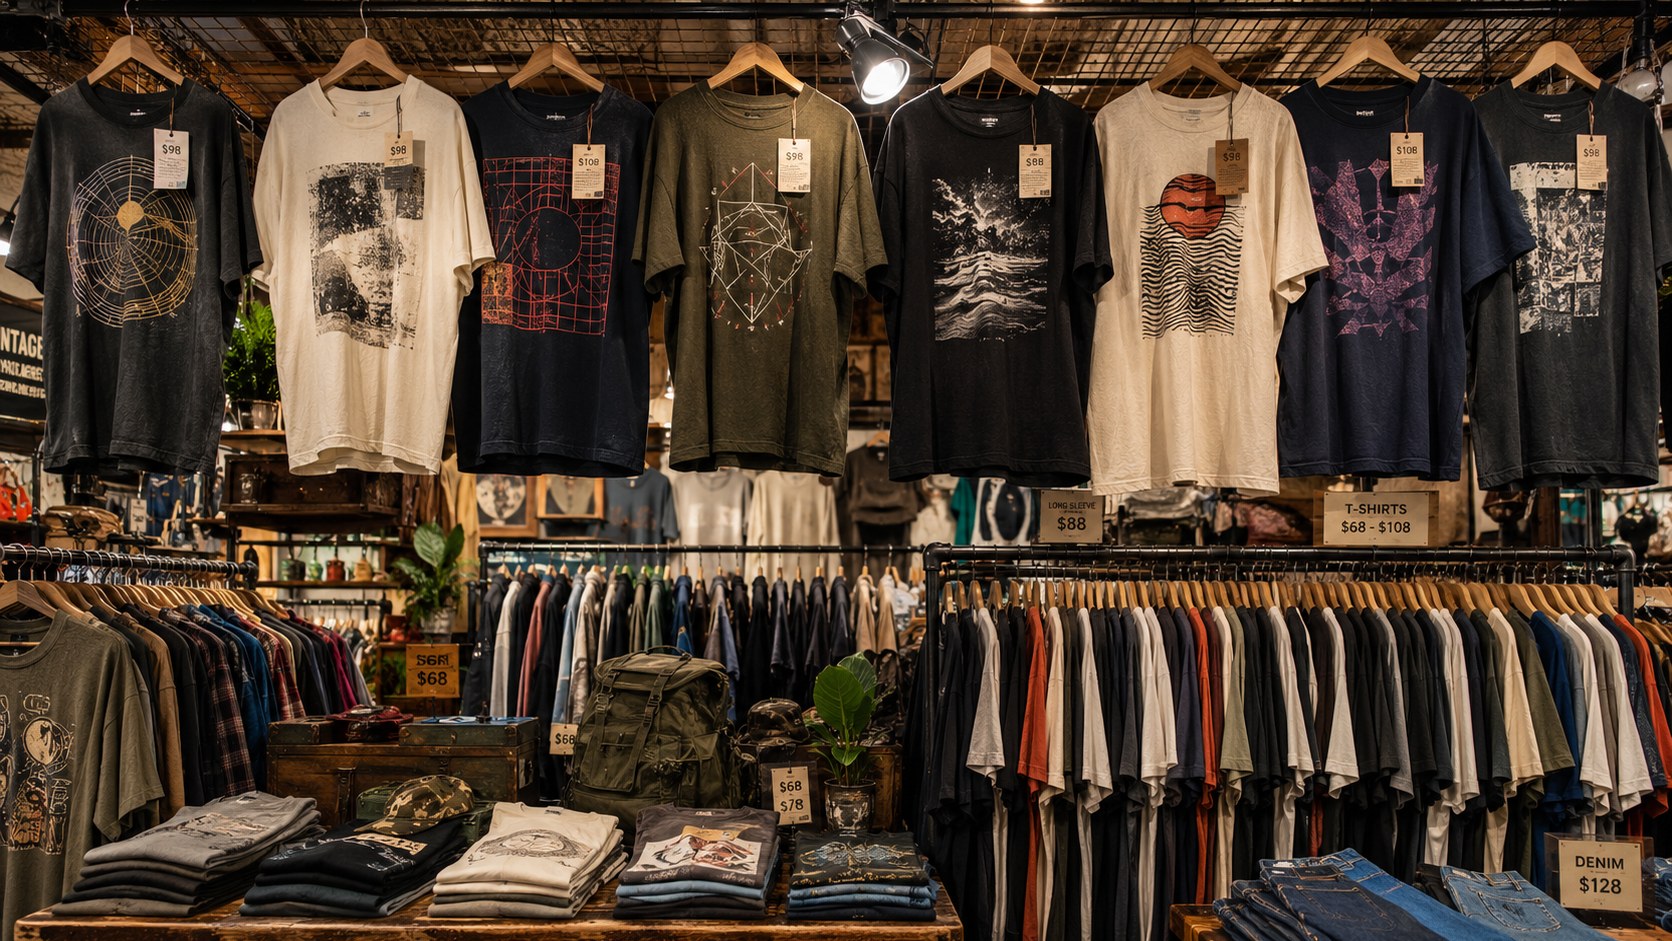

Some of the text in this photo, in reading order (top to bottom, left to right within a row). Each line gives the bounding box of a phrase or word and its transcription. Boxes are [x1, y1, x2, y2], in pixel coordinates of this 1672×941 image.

[162, 144, 181, 155] $98
[390, 145, 407, 156] $98
[1396, 146, 1418, 155] $108
[1583, 148, 1600, 157] $98
[786, 151, 803, 161] $98
[1222, 152, 1241, 162] $98
[578, 157, 600, 167] $108
[1069, 501, 1096, 510] SLEEVE
[1345, 503, 1407, 515] T-SHIRTS
[1057, 516, 1086, 531] $88
[1341, 520, 1366, 533] $68
[1378, 520, 1411, 533] $108
[417, 671, 448, 686] $68
[780, 780, 802, 793] $68
[780, 798, 804, 812] $78
[1575, 855, 1624, 870] DENIM
[1579, 876, 1622, 894] $128
